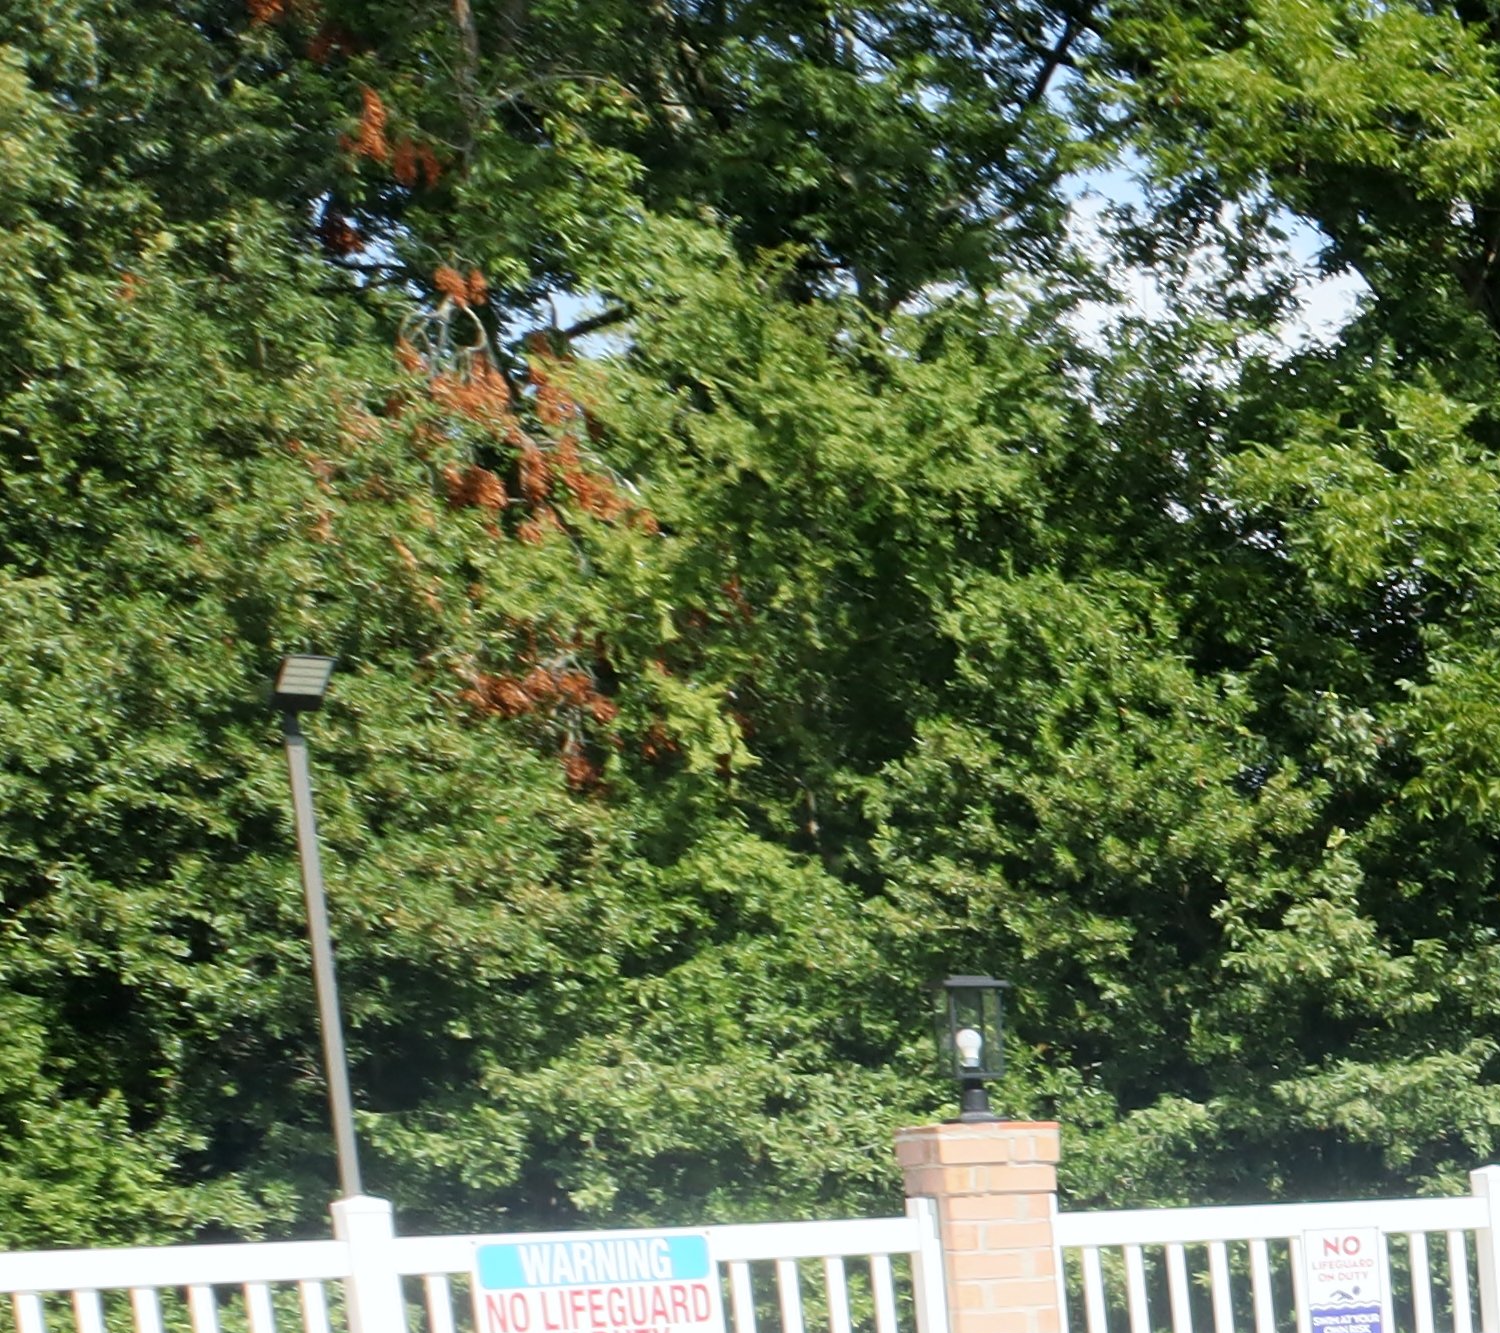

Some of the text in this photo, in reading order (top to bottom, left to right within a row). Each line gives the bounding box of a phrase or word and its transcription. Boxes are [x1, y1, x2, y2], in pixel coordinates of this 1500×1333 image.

[1322, 1235, 1361, 1257] NO
[517, 1238, 673, 1286] WARNING
[1312, 1258, 1375, 1270] LIFEGUARD
[1318, 1271, 1368, 1282] ON DUTY
[486, 1283, 711, 1333] NO LIFEGUARD
